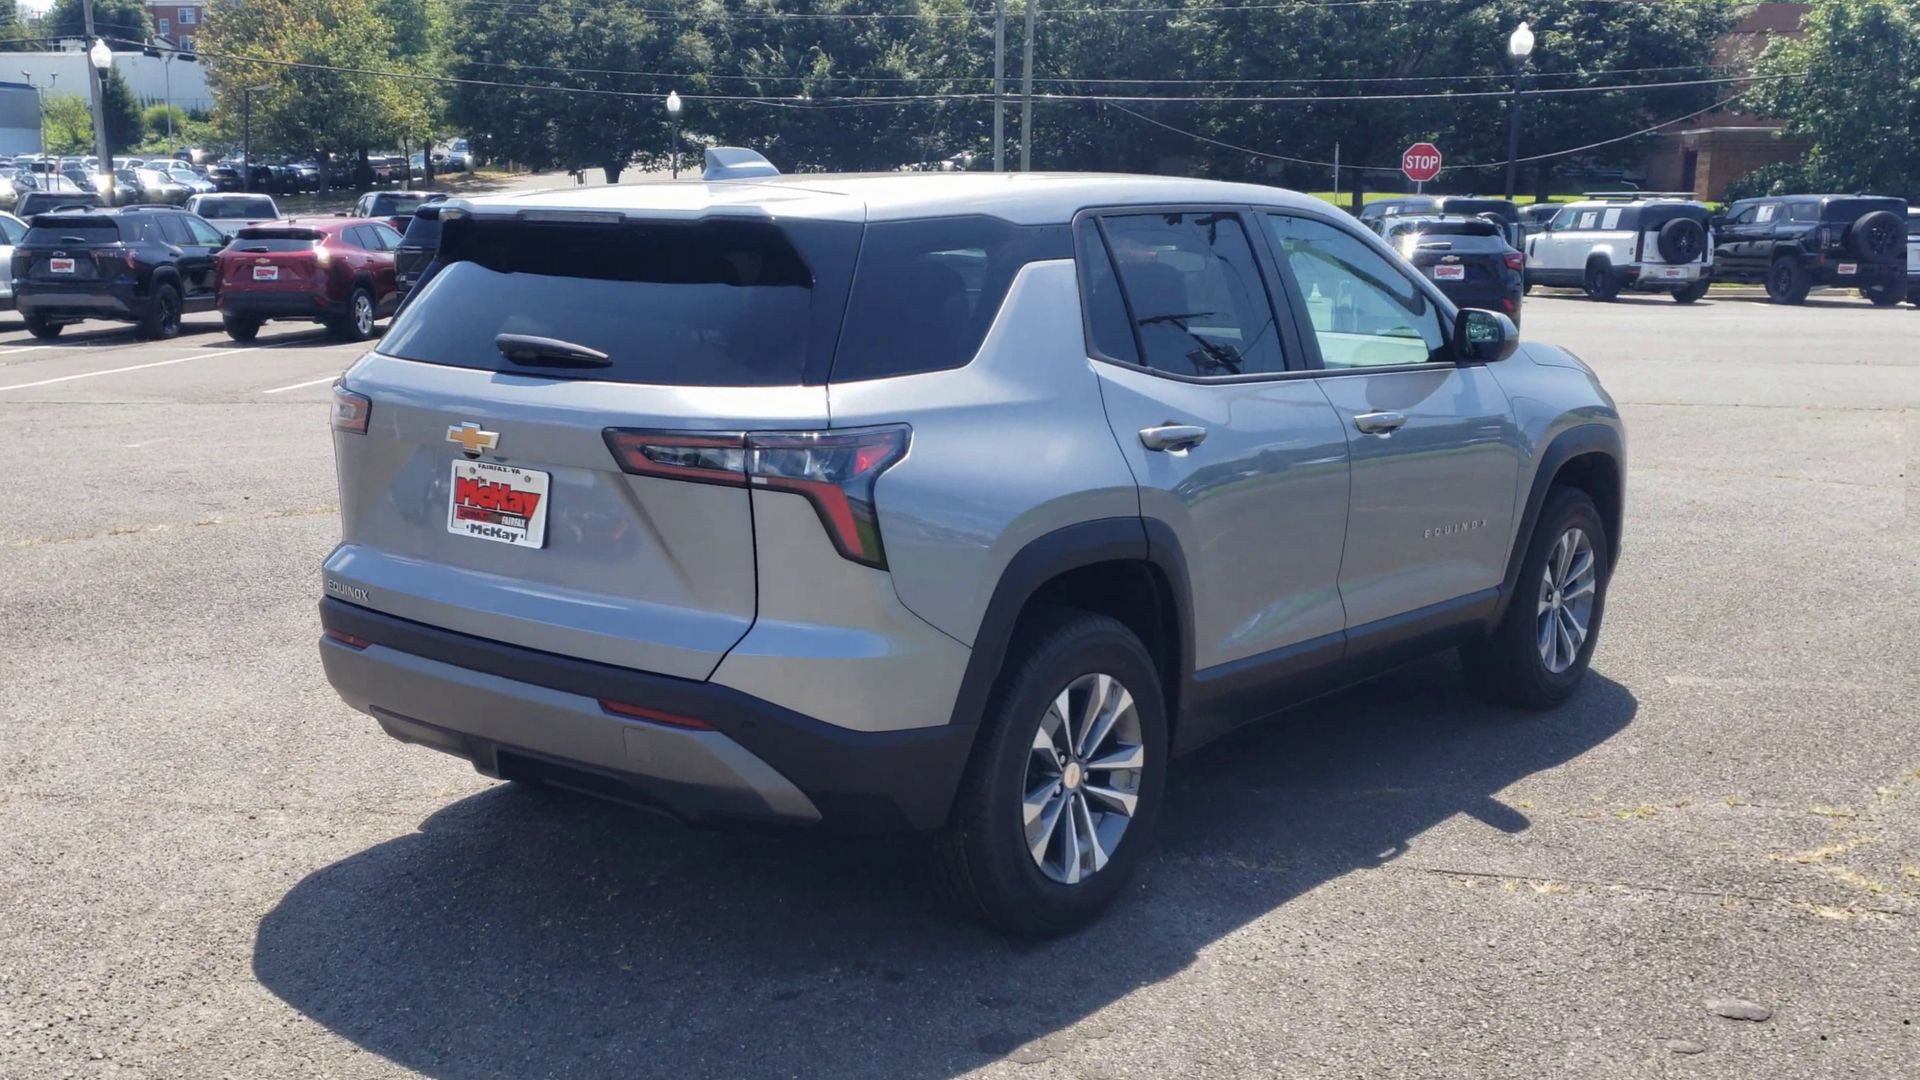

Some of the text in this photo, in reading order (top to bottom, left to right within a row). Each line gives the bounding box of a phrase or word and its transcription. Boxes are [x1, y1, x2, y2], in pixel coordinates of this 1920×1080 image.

[1405, 155, 1439, 169] STOP
[455, 476, 541, 520] McKay
[469, 523, 519, 542] McKay
[1423, 519, 1487, 539] EQUINOX
[328, 579, 369, 601] EQUINOX
